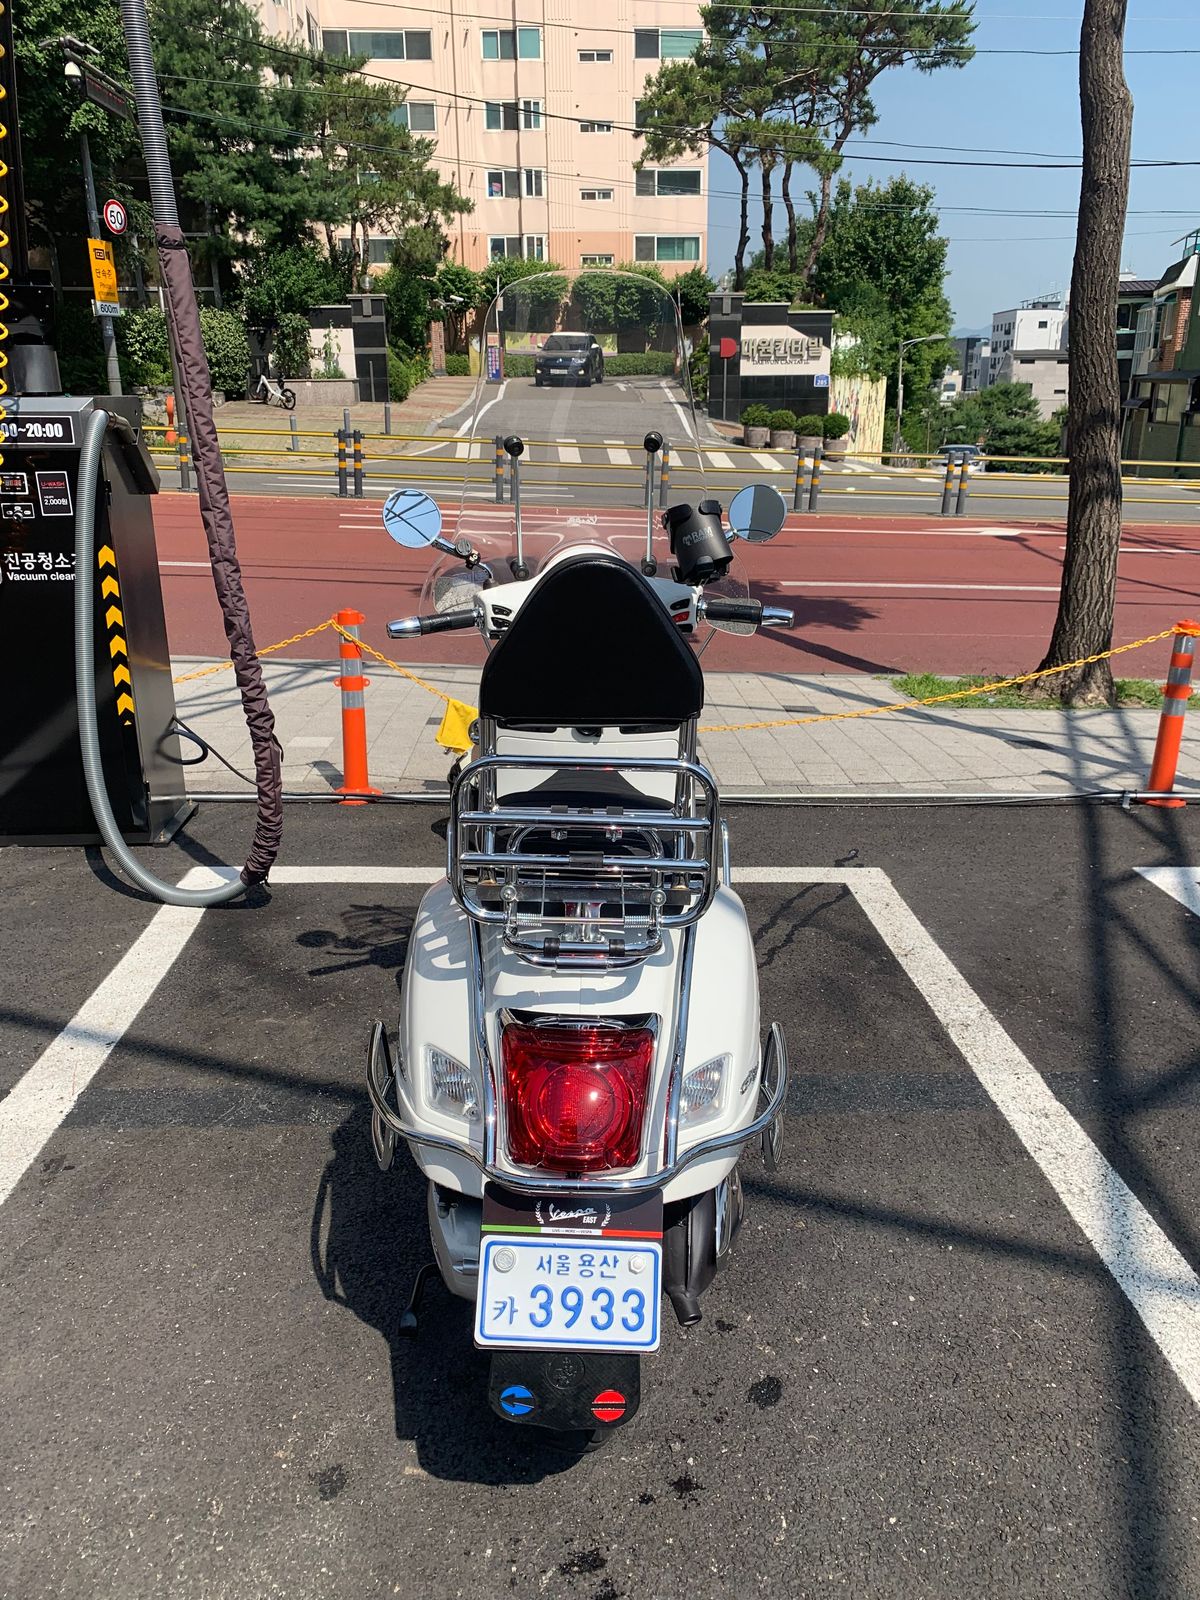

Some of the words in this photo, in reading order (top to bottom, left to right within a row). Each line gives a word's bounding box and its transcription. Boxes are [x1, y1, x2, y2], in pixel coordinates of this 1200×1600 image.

[109, 210, 123, 226] 50
[100, 304, 118, 314] 600m
[741, 337, 823, 360] 대원칸타빌
[44, 498, 68, 506] 2,000원
[6, 572, 48, 581] Vacuum
[548, 1202, 598, 1222] Vespa
[582, 1216, 597, 1224] EAST
[536, 1254, 571, 1276] 서울
[578, 1254, 620, 1279] 용산
[492, 1296, 519, 1326] 카
[529, 1284, 646, 1332] 3933
